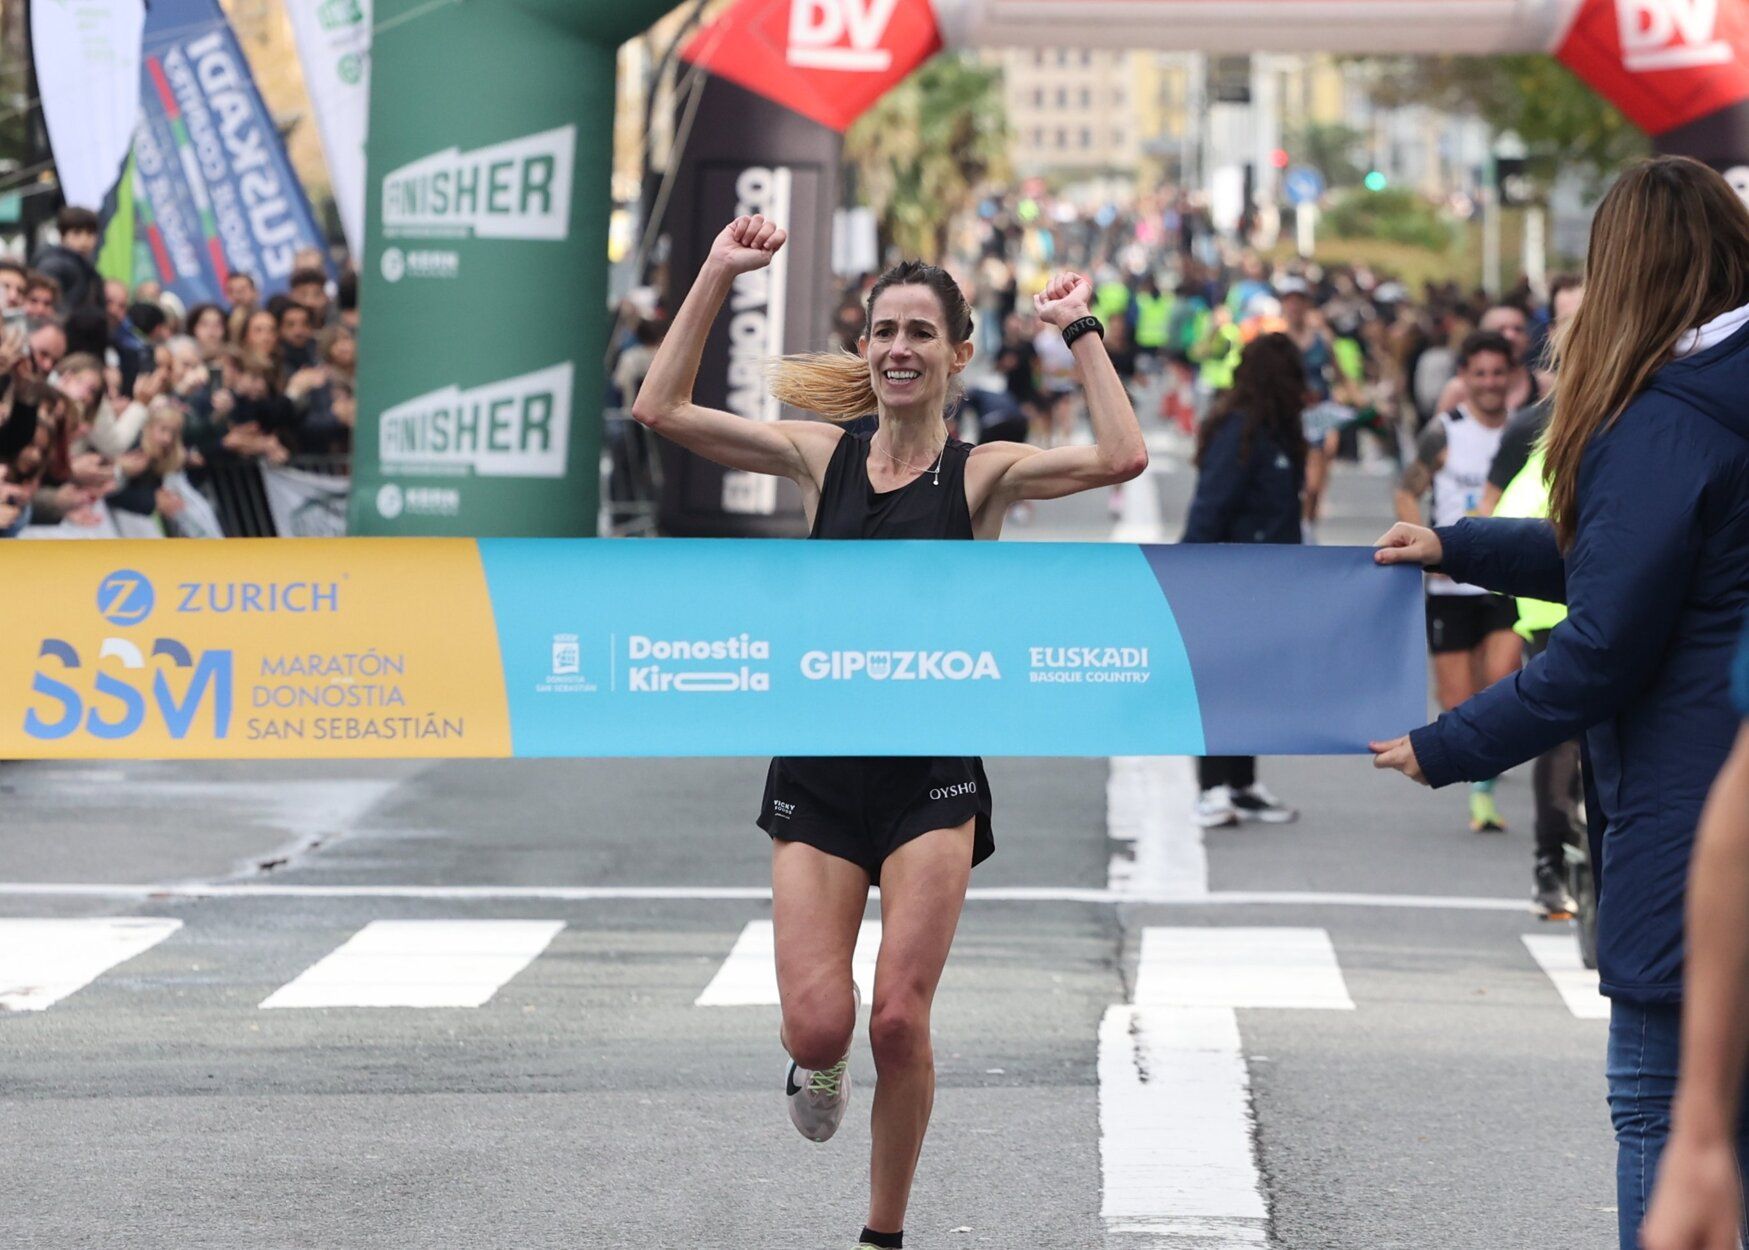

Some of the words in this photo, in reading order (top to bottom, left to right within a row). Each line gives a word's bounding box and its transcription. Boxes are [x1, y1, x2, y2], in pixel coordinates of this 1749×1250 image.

[788, 0, 899, 48] DV
[1614, 0, 1720, 47] DV
[386, 153, 555, 216] FINISHER
[1064, 317, 1096, 340] UNTO
[385, 391, 553, 454] FINISHER
[176, 582, 339, 612] ZURICH
[629, 633, 770, 660] Donostia
[1029, 646, 1149, 669] EUSKADI
[260, 647, 405, 677] MARATÓN
[800, 650, 1001, 681] GIPUZKOA
[1029, 671, 1082, 683] BASQUE
[1086, 671, 1151, 683] COUNTRY
[22, 636, 233, 740] SSM
[252, 684, 405, 708] DONOSTIA
[246, 717, 305, 740] SAN
[313, 711, 464, 740] SEBASTIÁN
[929, 781, 977, 801] OYSHO
